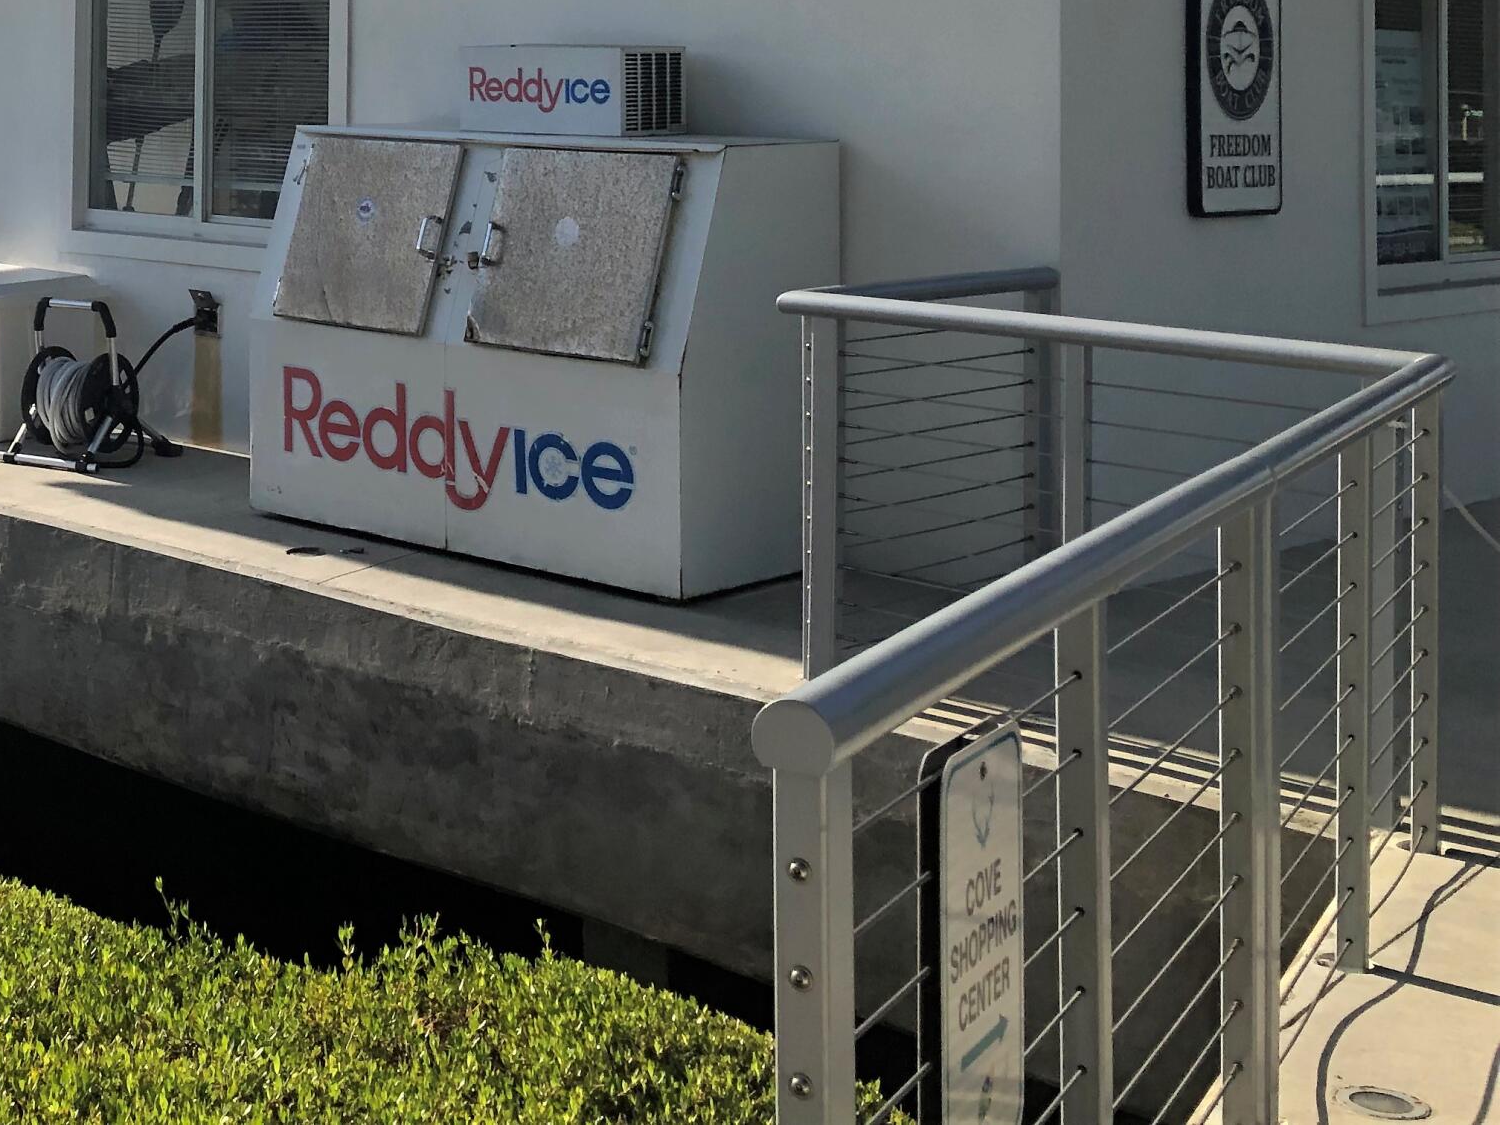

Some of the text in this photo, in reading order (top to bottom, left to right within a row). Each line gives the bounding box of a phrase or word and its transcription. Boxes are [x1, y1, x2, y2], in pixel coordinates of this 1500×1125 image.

[1209, 134, 1271, 157] FREEDOM
[1206, 164, 1276, 189] BOAT CLUB
[965, 856, 1002, 916] COVE
[950, 899, 1017, 984] SHOPPING
[958, 956, 1010, 1032] CENTER
